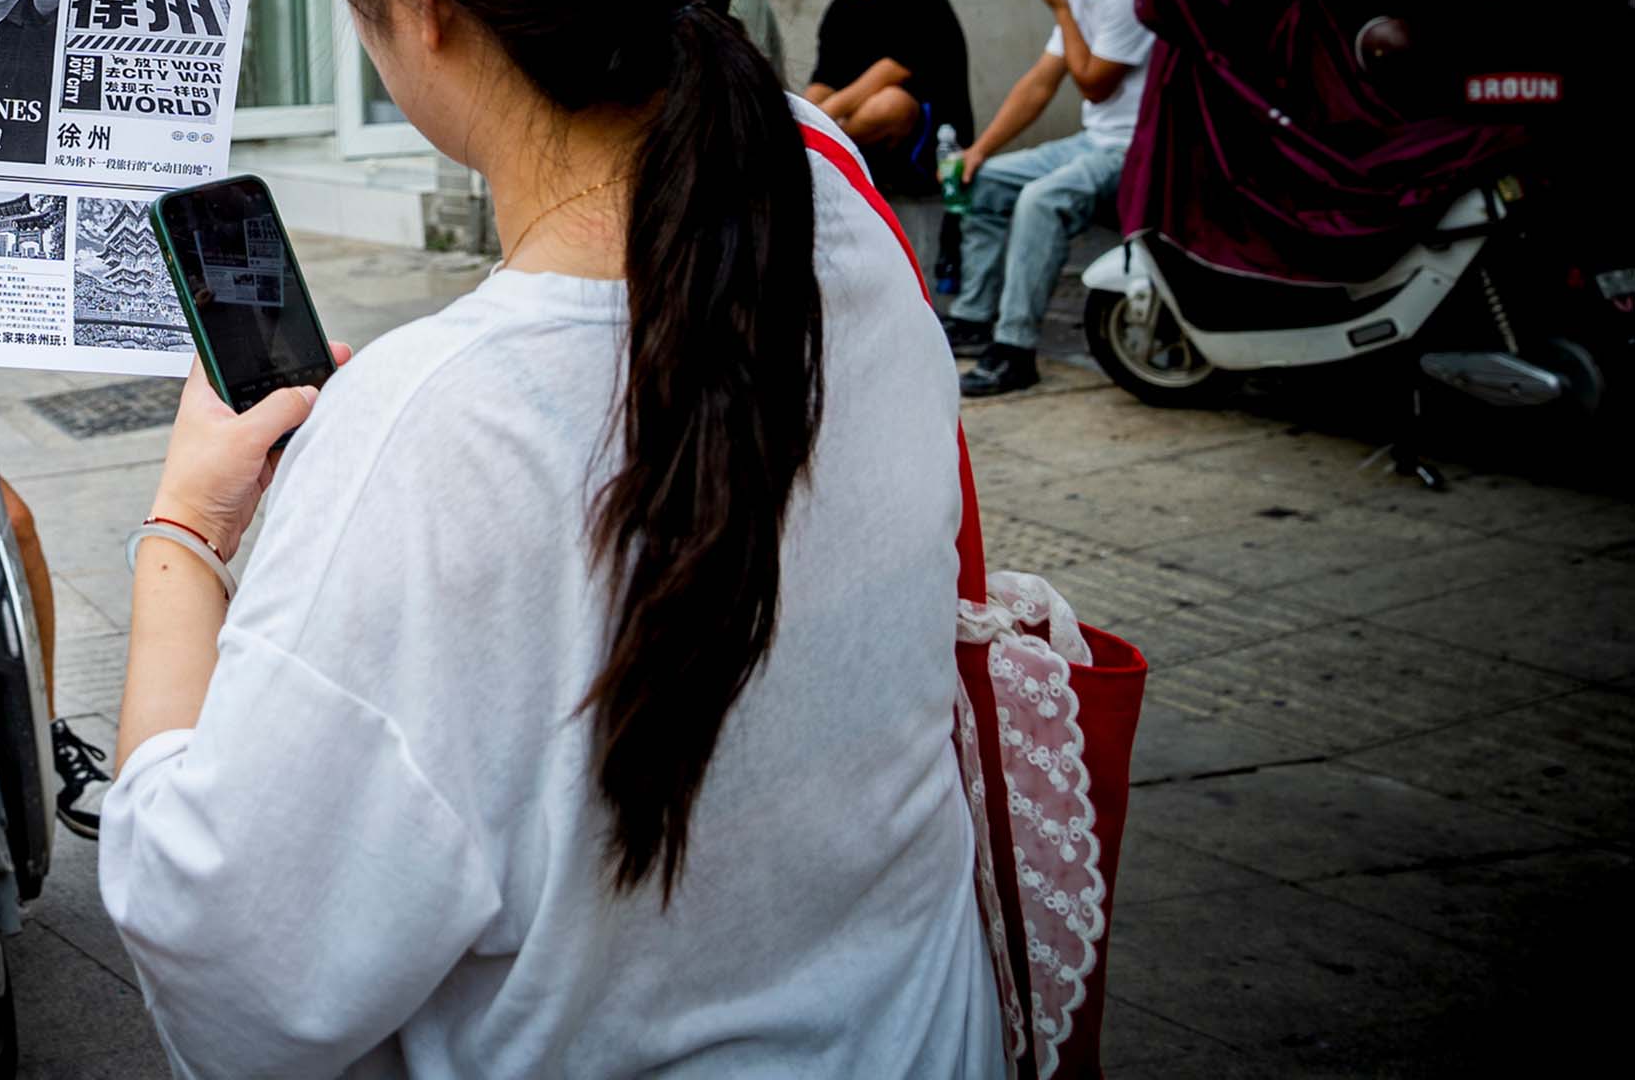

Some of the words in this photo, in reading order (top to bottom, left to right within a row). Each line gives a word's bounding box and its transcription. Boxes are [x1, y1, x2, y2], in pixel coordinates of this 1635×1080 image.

[81, 56, 96, 82] STAR
[64, 77, 81, 104] CITY
[104, 81, 210, 99] 发现不一样的
[105, 94, 212, 117] WORLD
[56, 123, 112, 151] 徐州
